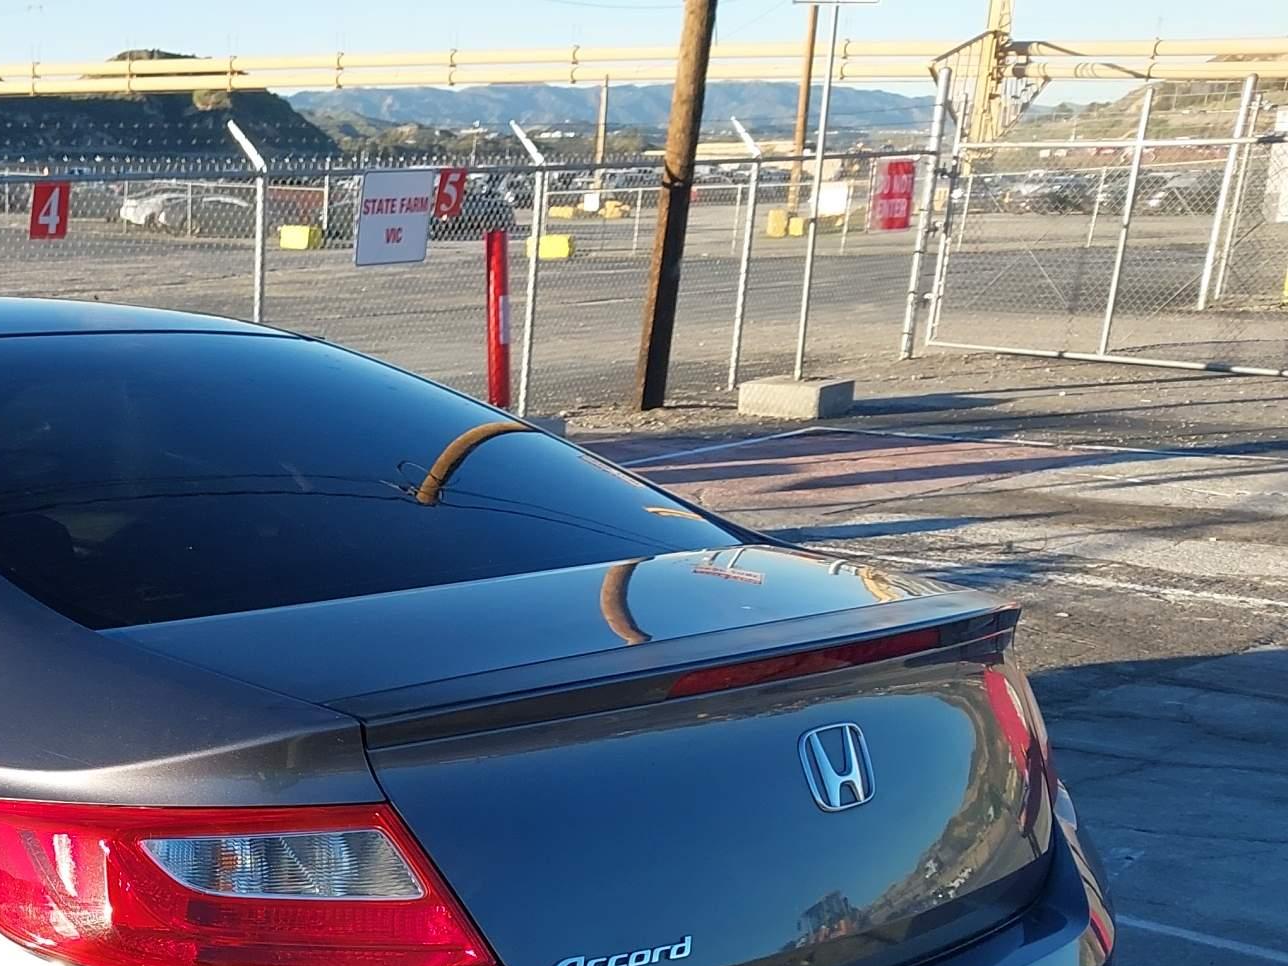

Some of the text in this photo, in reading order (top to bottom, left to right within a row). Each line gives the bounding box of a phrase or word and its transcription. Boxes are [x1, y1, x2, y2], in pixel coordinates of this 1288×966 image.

[441, 173, 461, 211] 5
[892, 173, 915, 194] NOT
[39, 187, 60, 234] 4
[363, 197, 429, 215] STATE FARM
[876, 198, 908, 218] ENTER
[385, 227, 403, 243] VIC
